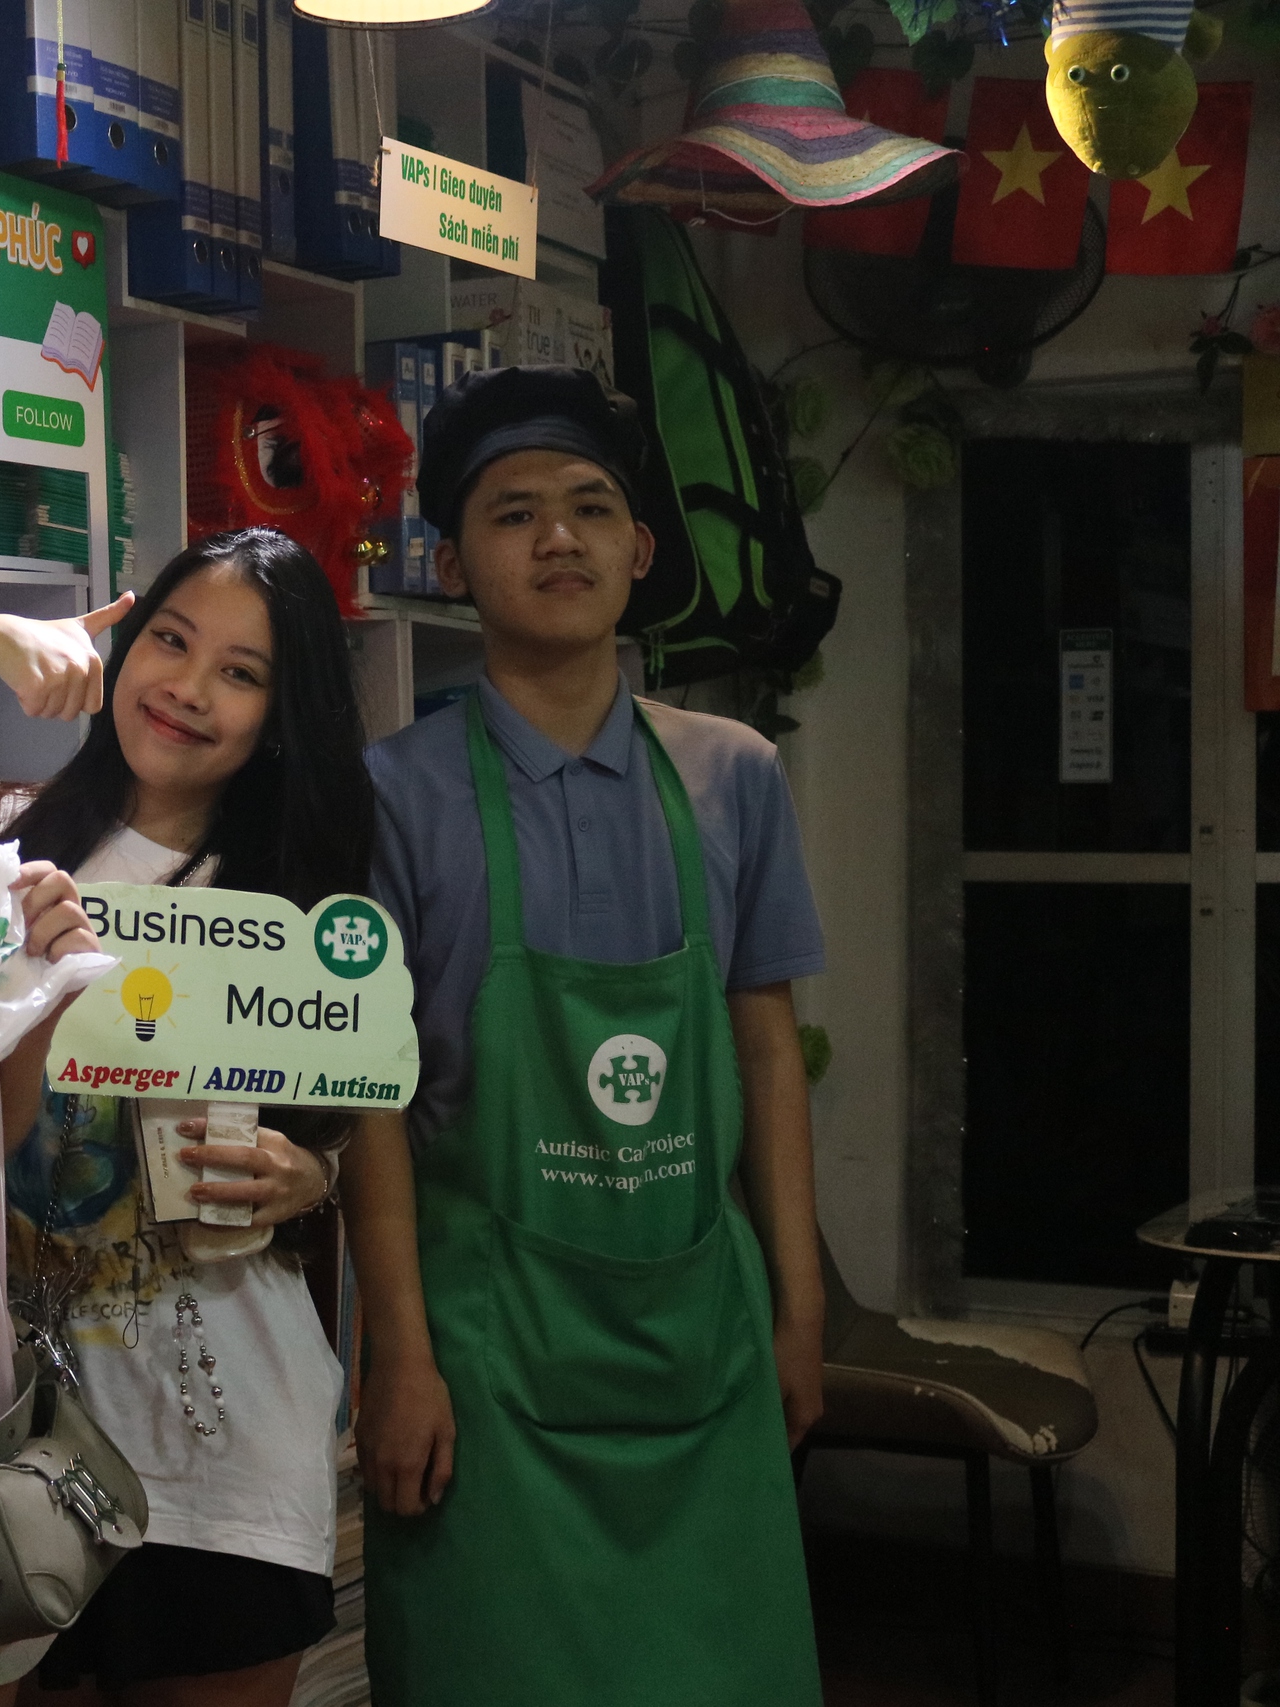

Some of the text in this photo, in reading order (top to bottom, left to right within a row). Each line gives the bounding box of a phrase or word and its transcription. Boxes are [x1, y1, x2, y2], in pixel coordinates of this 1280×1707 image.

[401, 153, 429, 188] VAPs
[440, 168, 466, 200] Gieo
[469, 179, 502, 213] duyên
[439, 212, 519, 261] Sách miễn phí
[15, 405, 73, 431] FOLLOW
[81, 896, 286, 951] Business
[339, 932, 366, 946] VAPs
[227, 984, 360, 1033] Model
[58, 1058, 401, 1101] Asperger ADHD Autism
[618, 1072, 650, 1086] VAPs
[535, 1139, 610, 1162] Autistic
